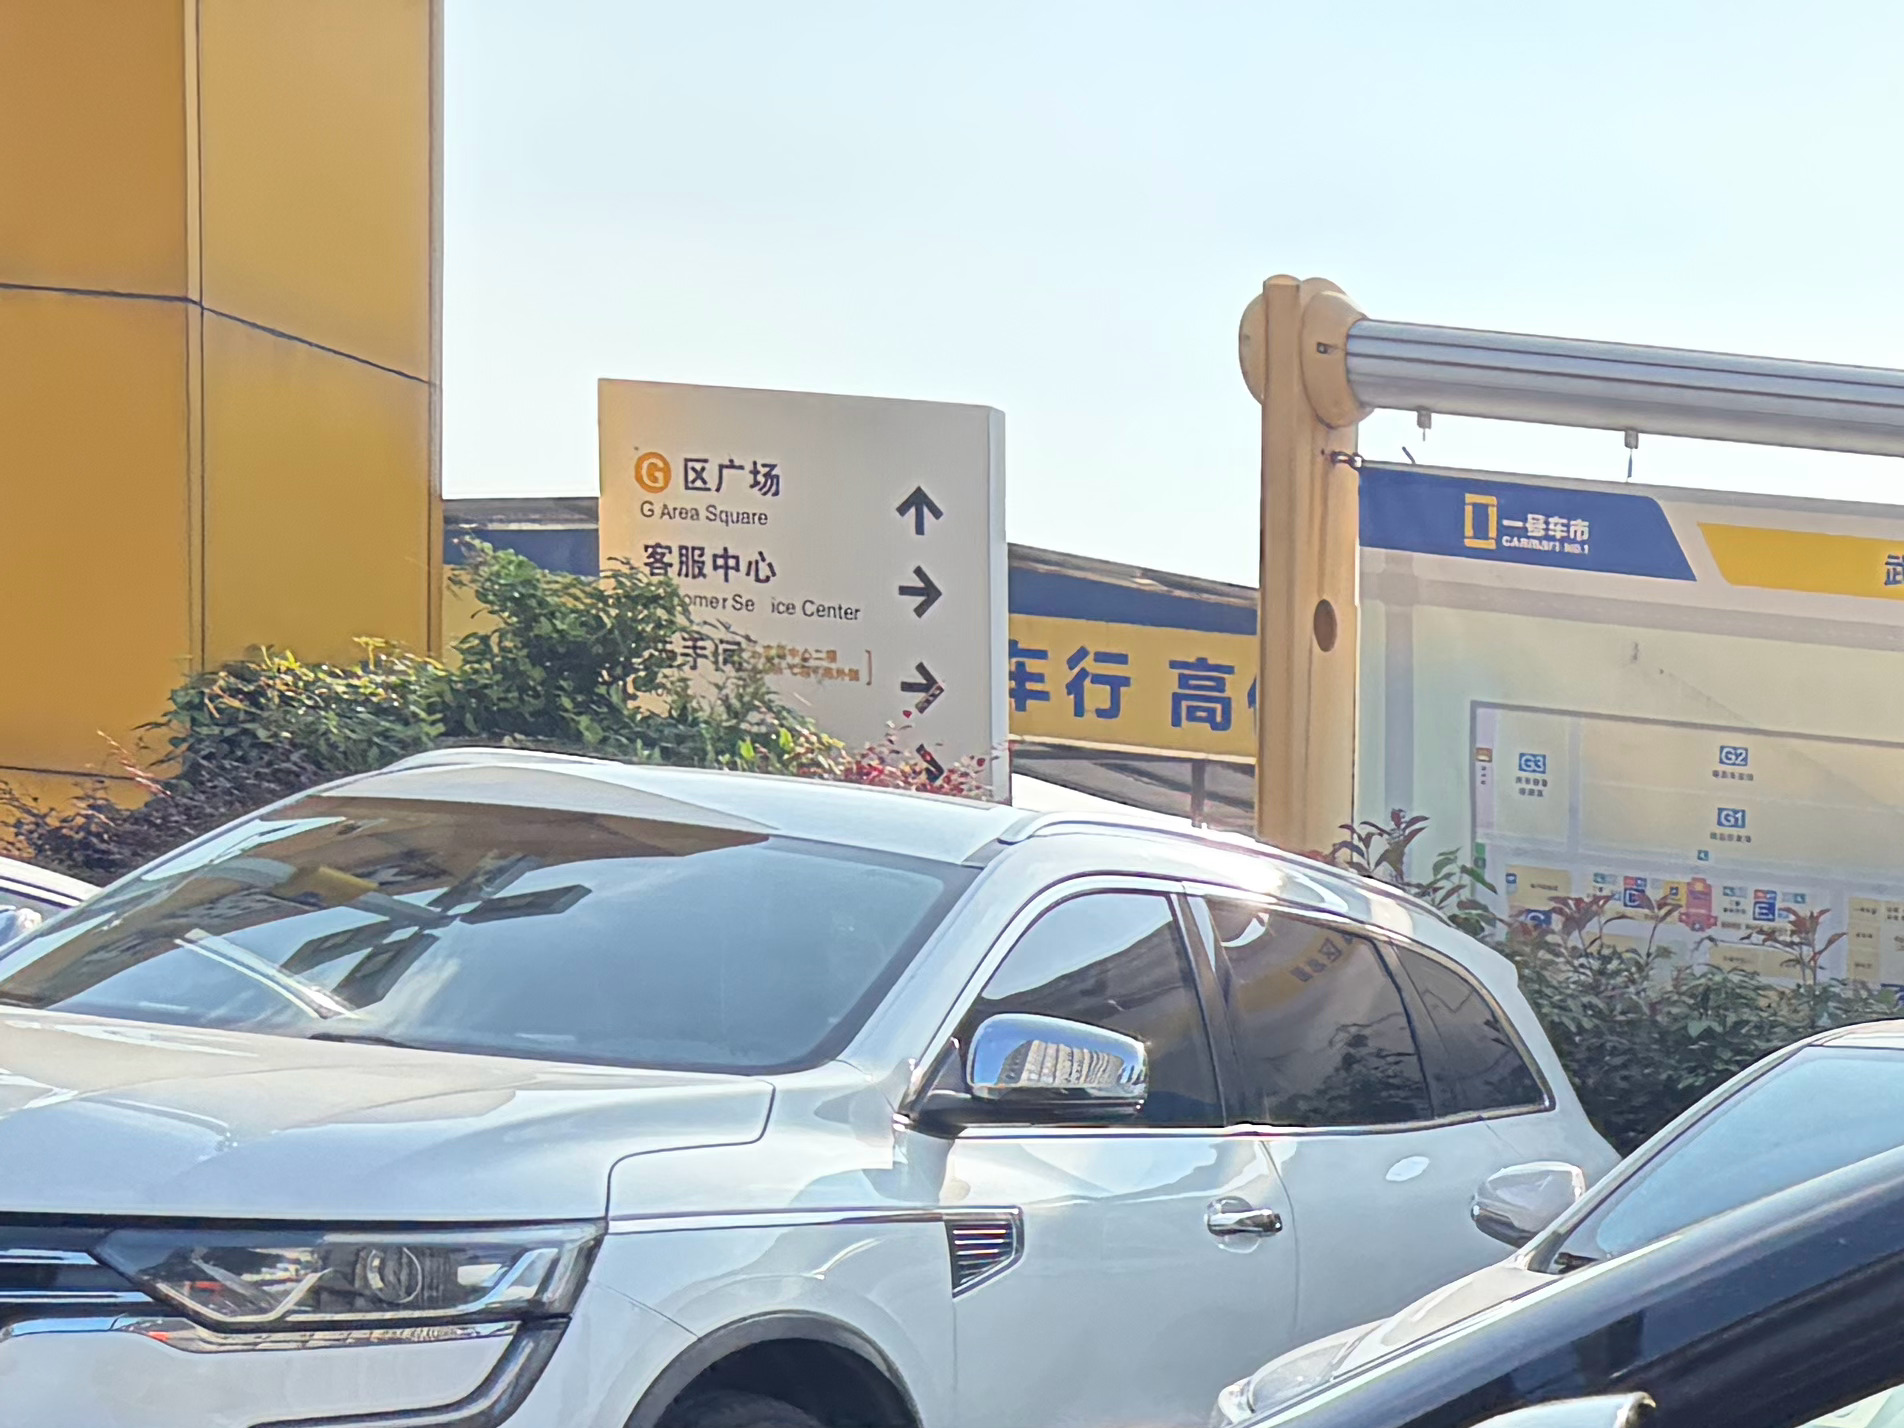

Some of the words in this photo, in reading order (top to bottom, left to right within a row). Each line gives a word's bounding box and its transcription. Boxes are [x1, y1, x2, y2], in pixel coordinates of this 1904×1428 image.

[640, 500, 655, 518] G
[660, 503, 700, 521] Area
[705, 504, 769, 527] Square
[1502, 513, 1590, 541] 一号车市
[643, 542, 778, 584] 客服中心
[801, 599, 861, 621] Center
[1520, 754, 1545, 772] G3
[1721, 747, 1747, 765] G2
[1720, 809, 1744, 827] G1
[1754, 902, 1774, 920] E
